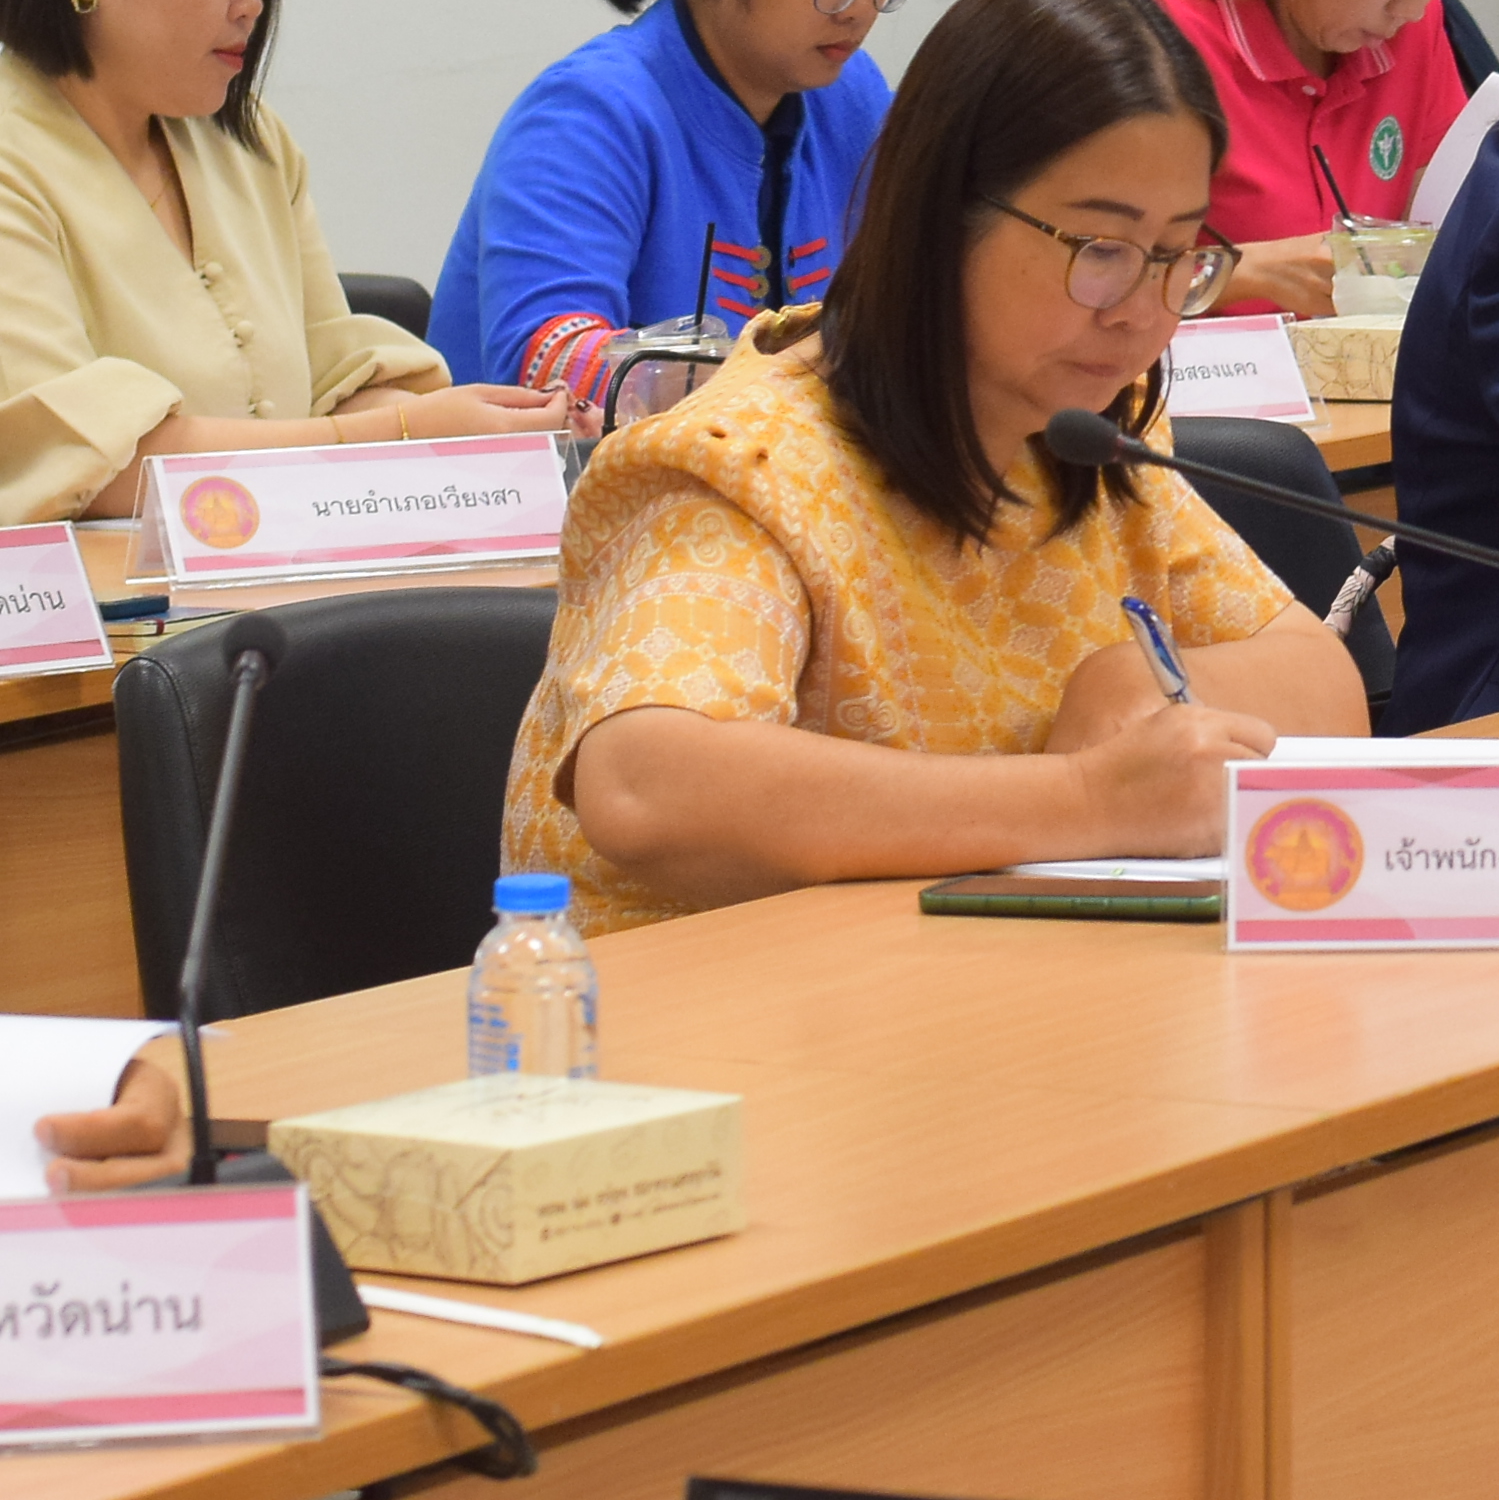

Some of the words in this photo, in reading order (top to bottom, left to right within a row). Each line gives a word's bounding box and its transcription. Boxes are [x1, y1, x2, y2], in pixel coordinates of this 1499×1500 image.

[1162, 361, 1258, 382] อสองแคว
[311, 484, 522, 517] นายอำเภอเวียงสา
